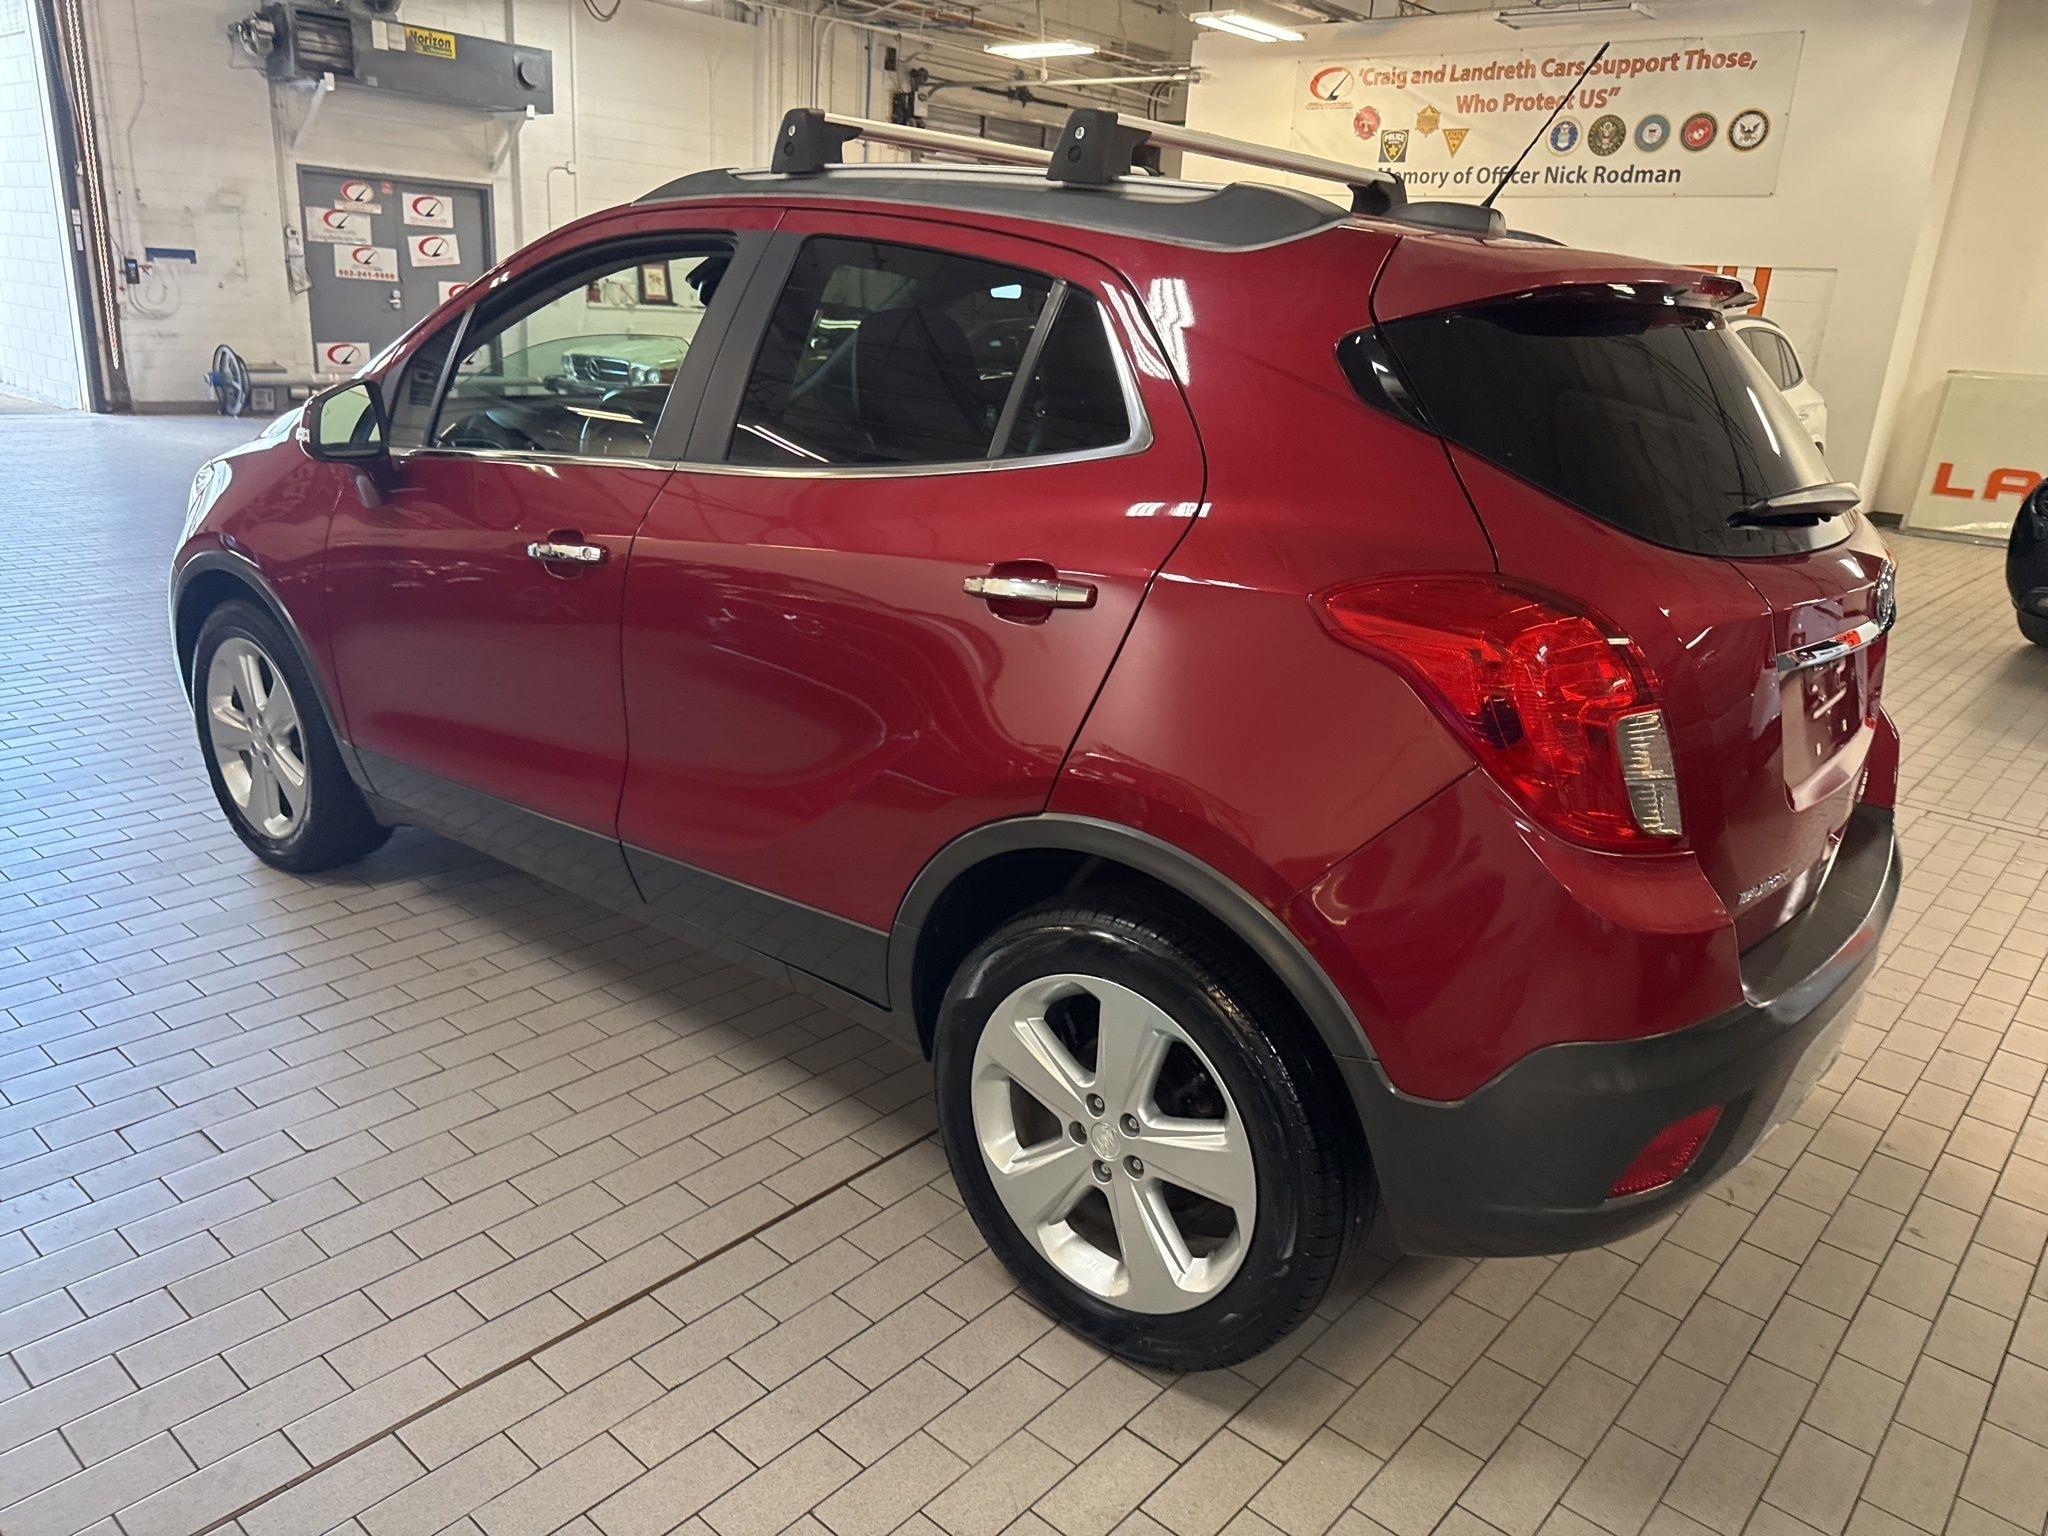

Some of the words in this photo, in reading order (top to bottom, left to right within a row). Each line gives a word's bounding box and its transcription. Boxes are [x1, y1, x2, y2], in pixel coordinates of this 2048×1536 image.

[1410, 64, 1447, 85] and
[1449, 59, 1536, 82] Landreth
[1541, 57, 1586, 77] Cars
[1590, 53, 1680, 79] Support
[1684, 48, 1758, 70] Those,
[1456, 93, 1499, 114] Who
[1502, 93, 1575, 112] Protect
[1378, 167, 1449, 188] mory
[1453, 166, 1474, 184] of
[1476, 165, 1540, 184] Offcer
[1544, 165, 1589, 184] Nick
[1593, 164, 1682, 184] Rodman
